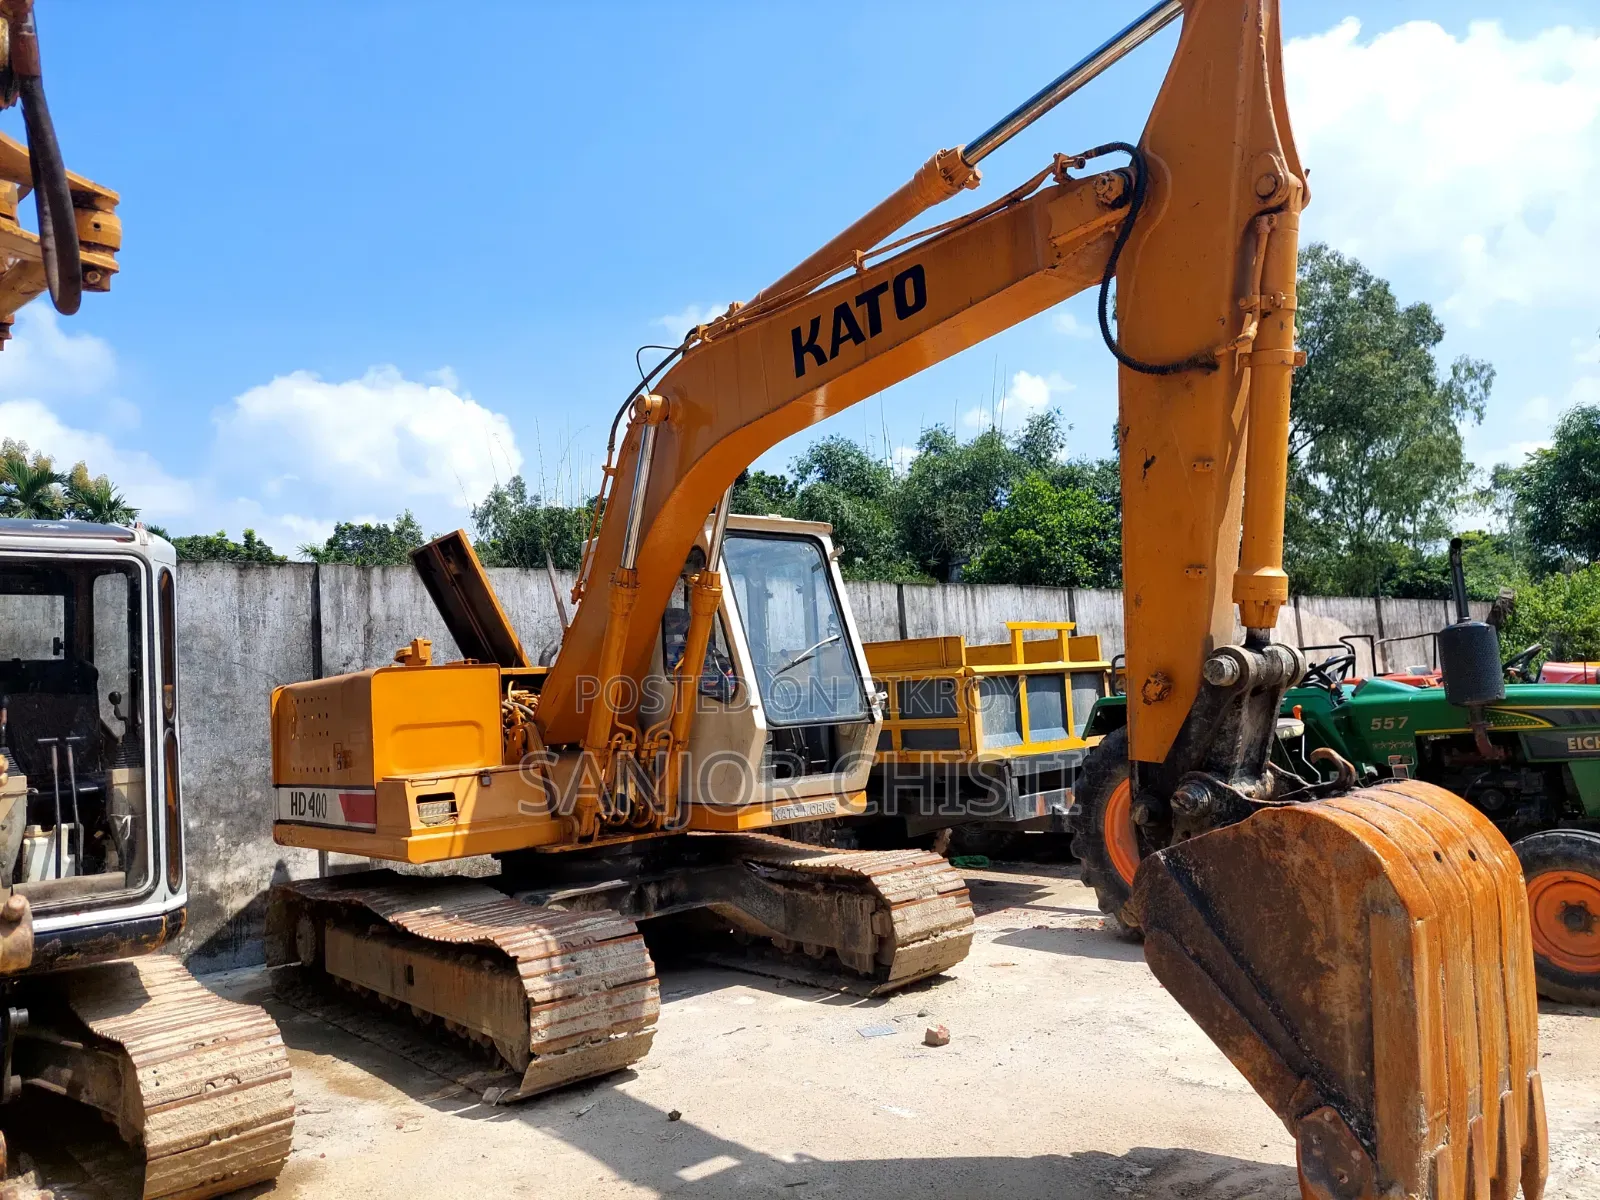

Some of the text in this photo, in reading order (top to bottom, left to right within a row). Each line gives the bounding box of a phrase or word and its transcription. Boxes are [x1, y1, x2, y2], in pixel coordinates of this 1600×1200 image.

[791, 263, 927, 379] KATO
[1371, 716, 1409, 730] 557
[773, 804, 801, 820] KATO
